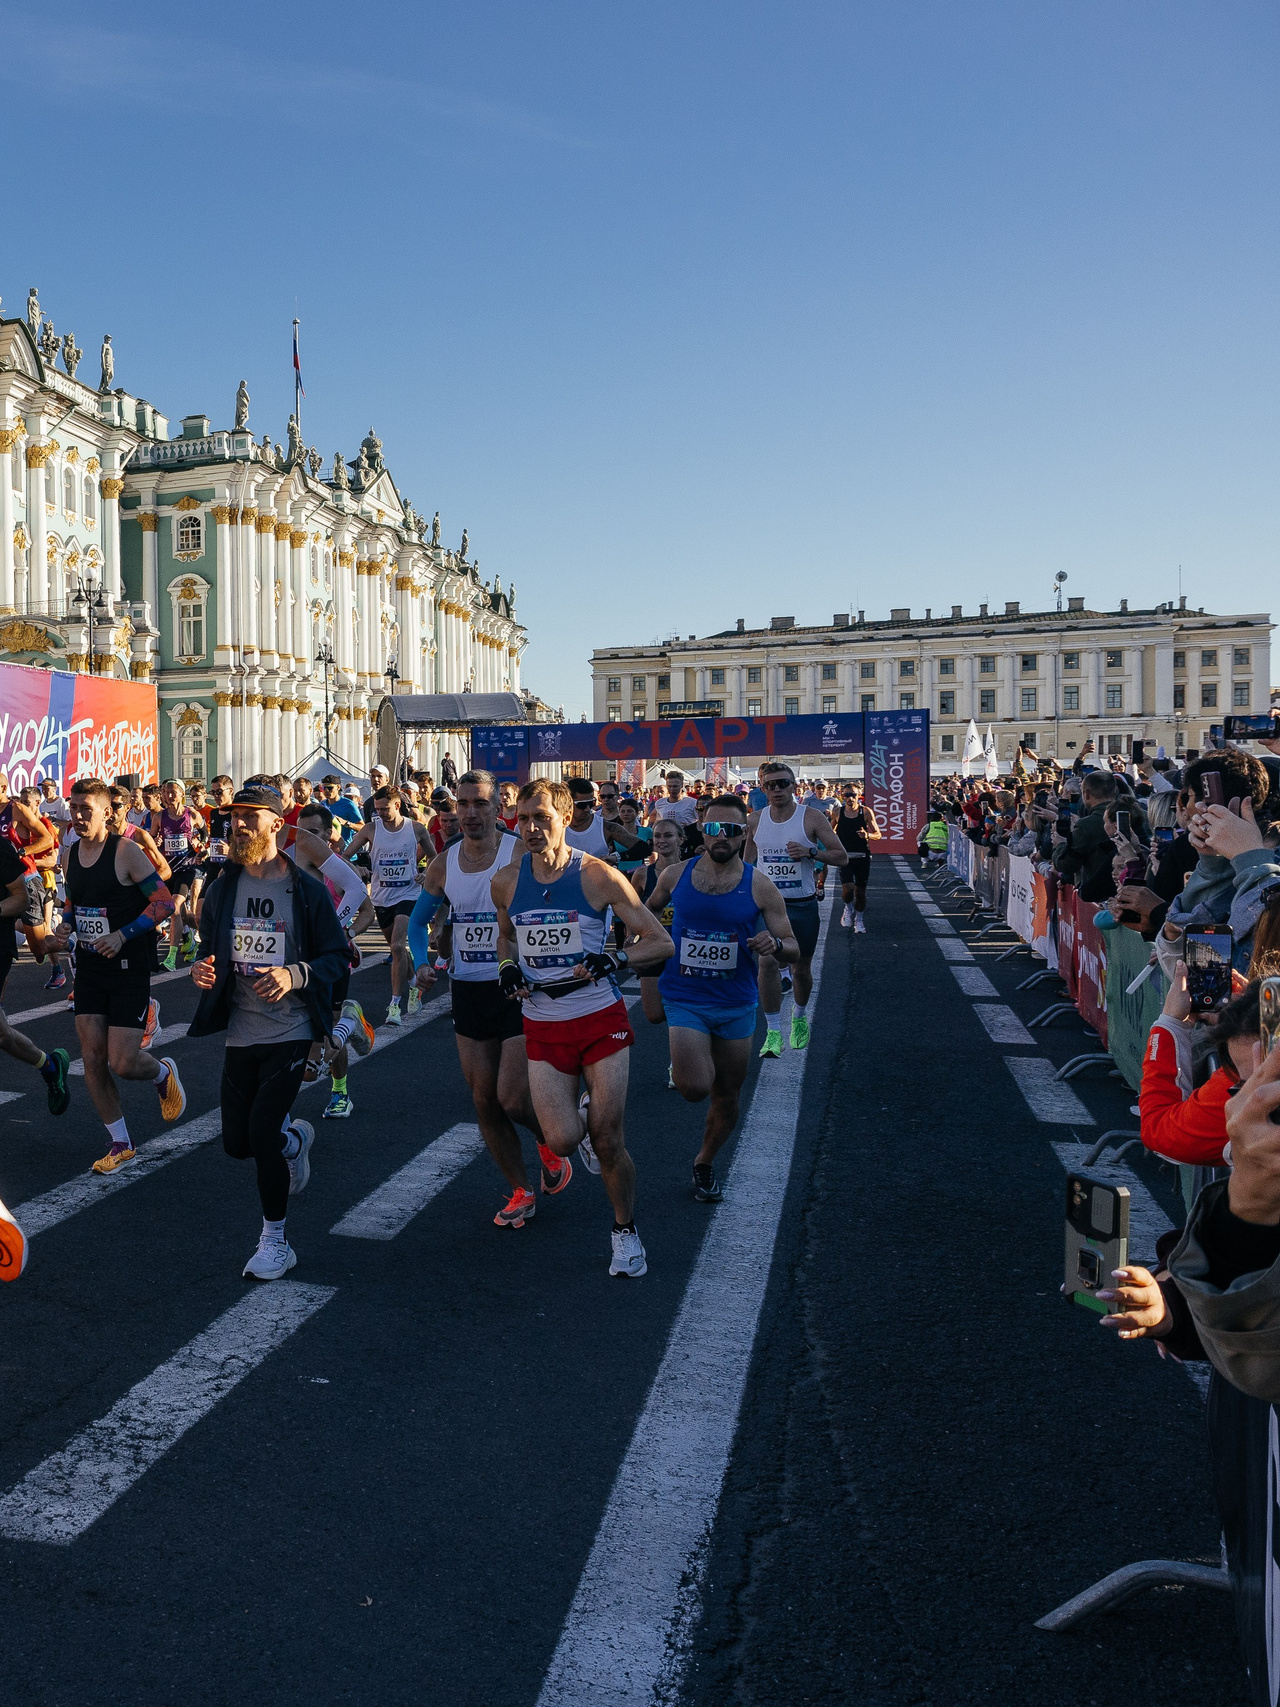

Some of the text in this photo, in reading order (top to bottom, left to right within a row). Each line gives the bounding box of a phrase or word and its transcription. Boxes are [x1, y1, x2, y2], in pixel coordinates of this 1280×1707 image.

[598, 715, 787, 758] СТАРТ
[869, 740, 888, 790] 2024
[889, 753, 904, 840] МАРАФОН
[382, 867, 406, 877] 3047
[767, 865, 797, 876] 3304
[246, 897, 274, 918] NO
[79, 919, 104, 934] 2258
[465, 926, 494, 942] 697
[233, 934, 277, 954] 3962
[526, 927, 572, 946] 6259
[687, 943, 731, 960] 2488
